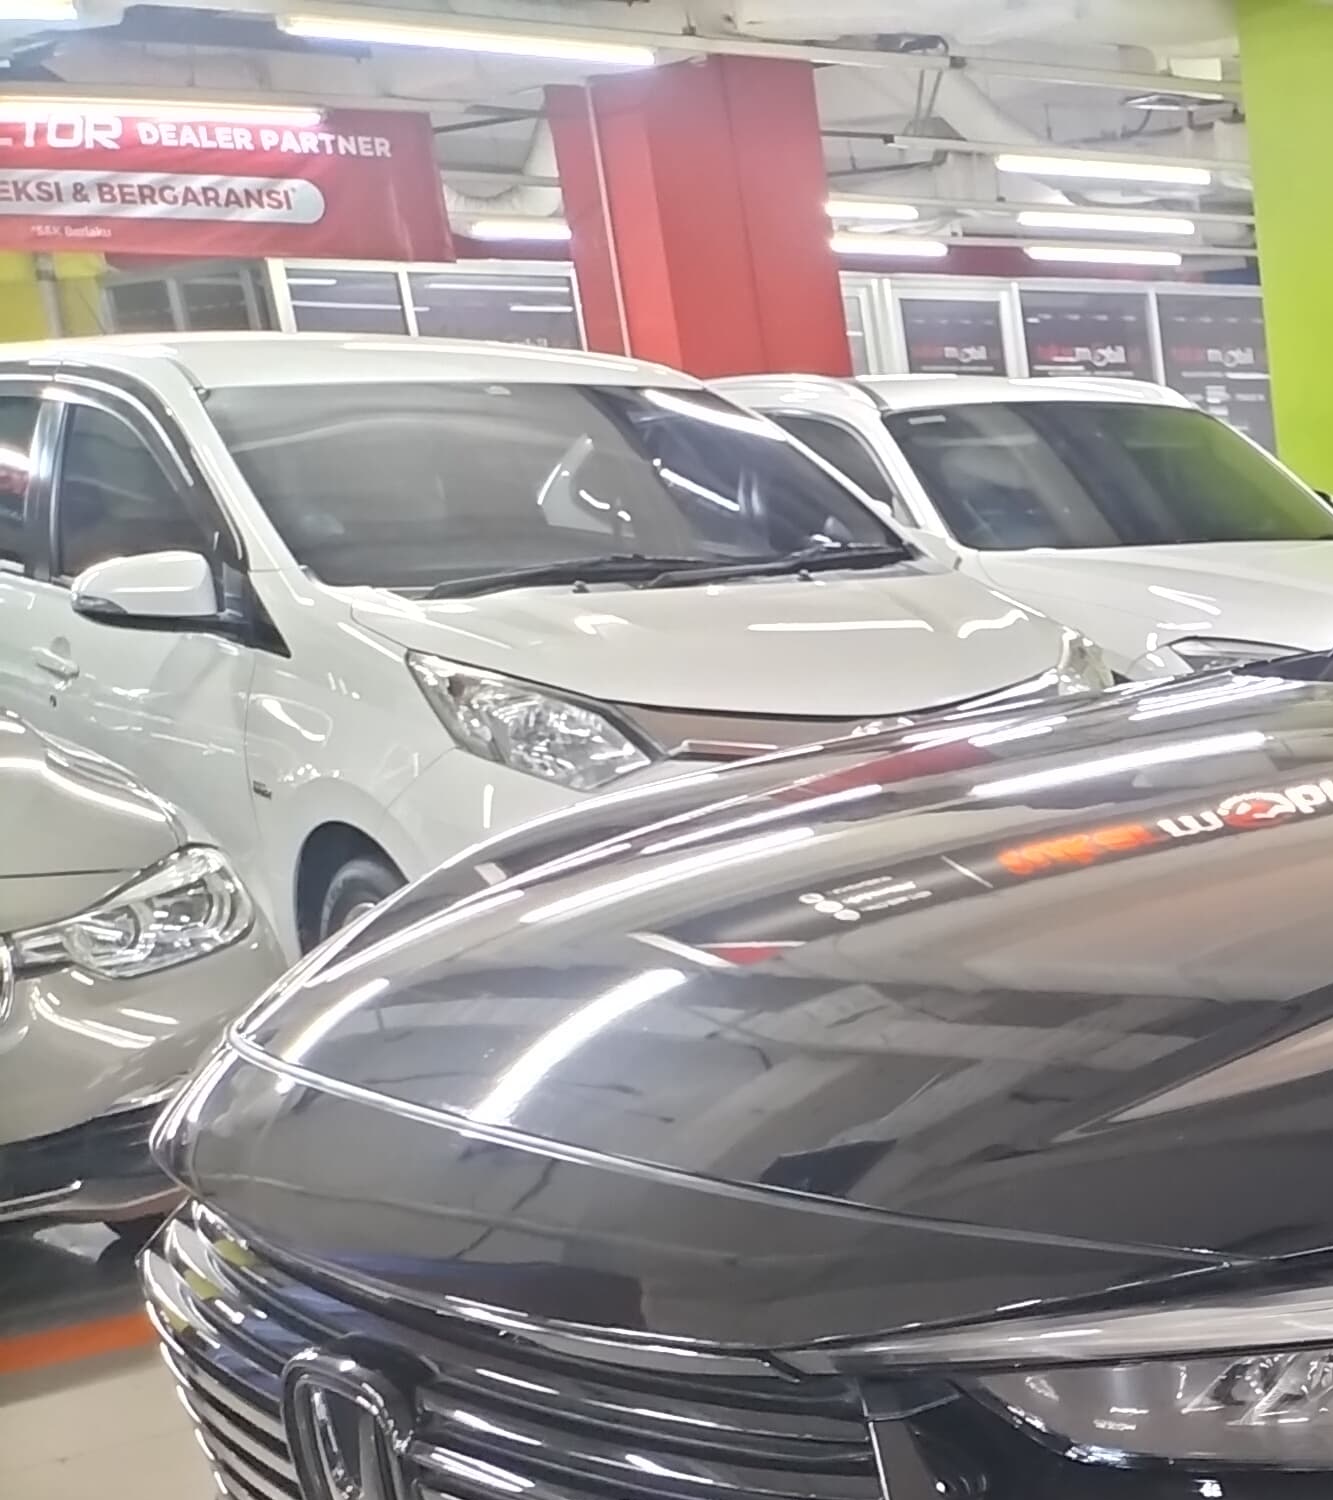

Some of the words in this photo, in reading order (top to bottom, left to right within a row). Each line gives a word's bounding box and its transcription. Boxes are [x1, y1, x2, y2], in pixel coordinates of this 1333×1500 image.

[137, 122, 255, 151] DEALER
[259, 129, 392, 158] PARTNER
[72, 182, 91, 203] &
